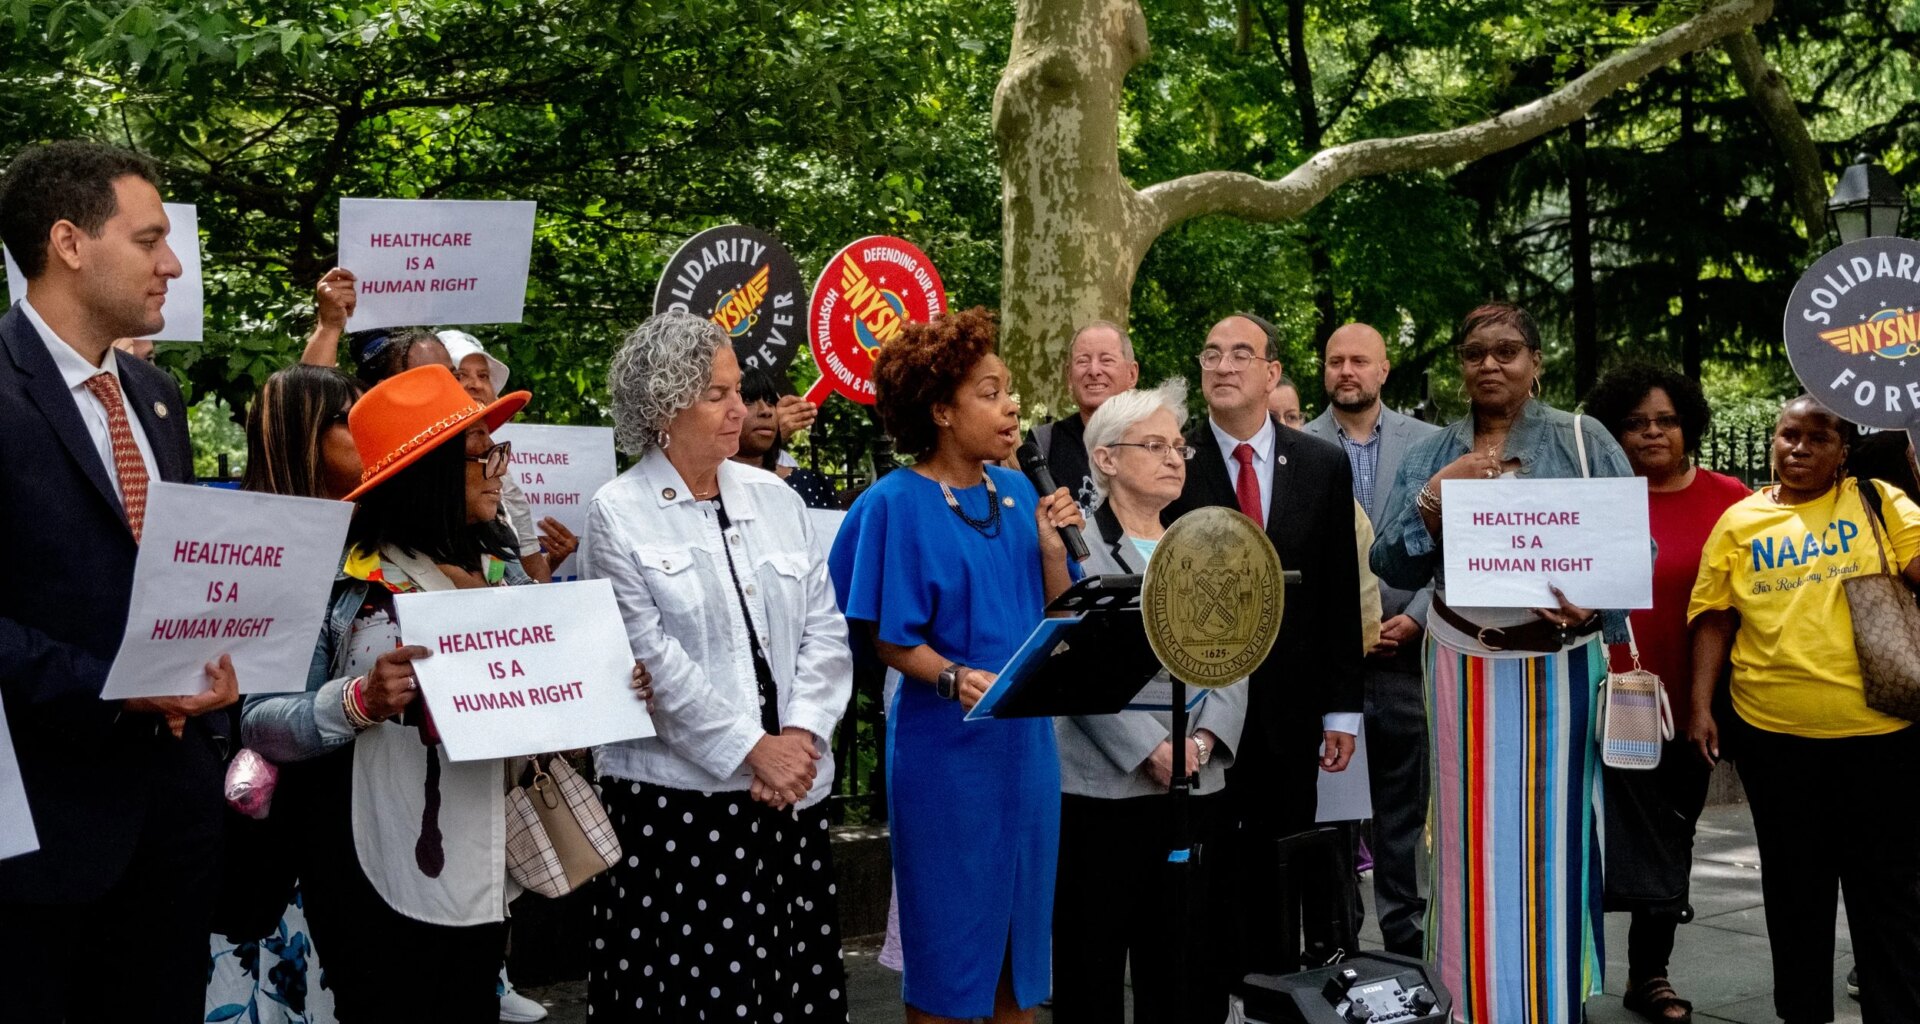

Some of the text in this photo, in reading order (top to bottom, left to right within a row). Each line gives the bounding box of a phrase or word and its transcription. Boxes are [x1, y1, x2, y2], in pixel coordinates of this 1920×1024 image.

[371, 233, 472, 247] HEALTHCARE
[406, 257, 434, 270] IS A
[668, 238, 766, 315] OLIDARITY
[362, 278, 478, 294] HUMAN RIGHT
[864, 247, 941, 325] DEFENDING OUR PATI
[1803, 252, 1920, 325] SOLIDAR
[843, 276, 904, 344] NYSN
[745, 291, 794, 369] REVER
[1849, 313, 1920, 354] NYSN
[826, 352, 854, 386] UNION
[853, 378, 861, 391] &
[1830, 368, 1920, 412] FORE
[509, 452, 569, 465] ALTHCARE
[521, 472, 545, 485] IS A
[544, 493, 580, 505] RIGHT
[1473, 512, 1580, 526] HEALTHCARE
[173, 541, 284, 567] HEALTHCARE
[1511, 535, 1543, 549] IS A
[1751, 519, 1858, 572] NAACP
[1468, 558, 1593, 572] HUMAN RIGHT
[206, 581, 238, 603] IS A
[151, 618, 274, 640] HUMAN RIGHT
[439, 624, 556, 654] HEALTHCARE
[488, 659, 525, 680] IS A
[1174, 647, 1231, 676] CIVITATIS
[453, 681, 584, 713] HUMAN RIGHT
